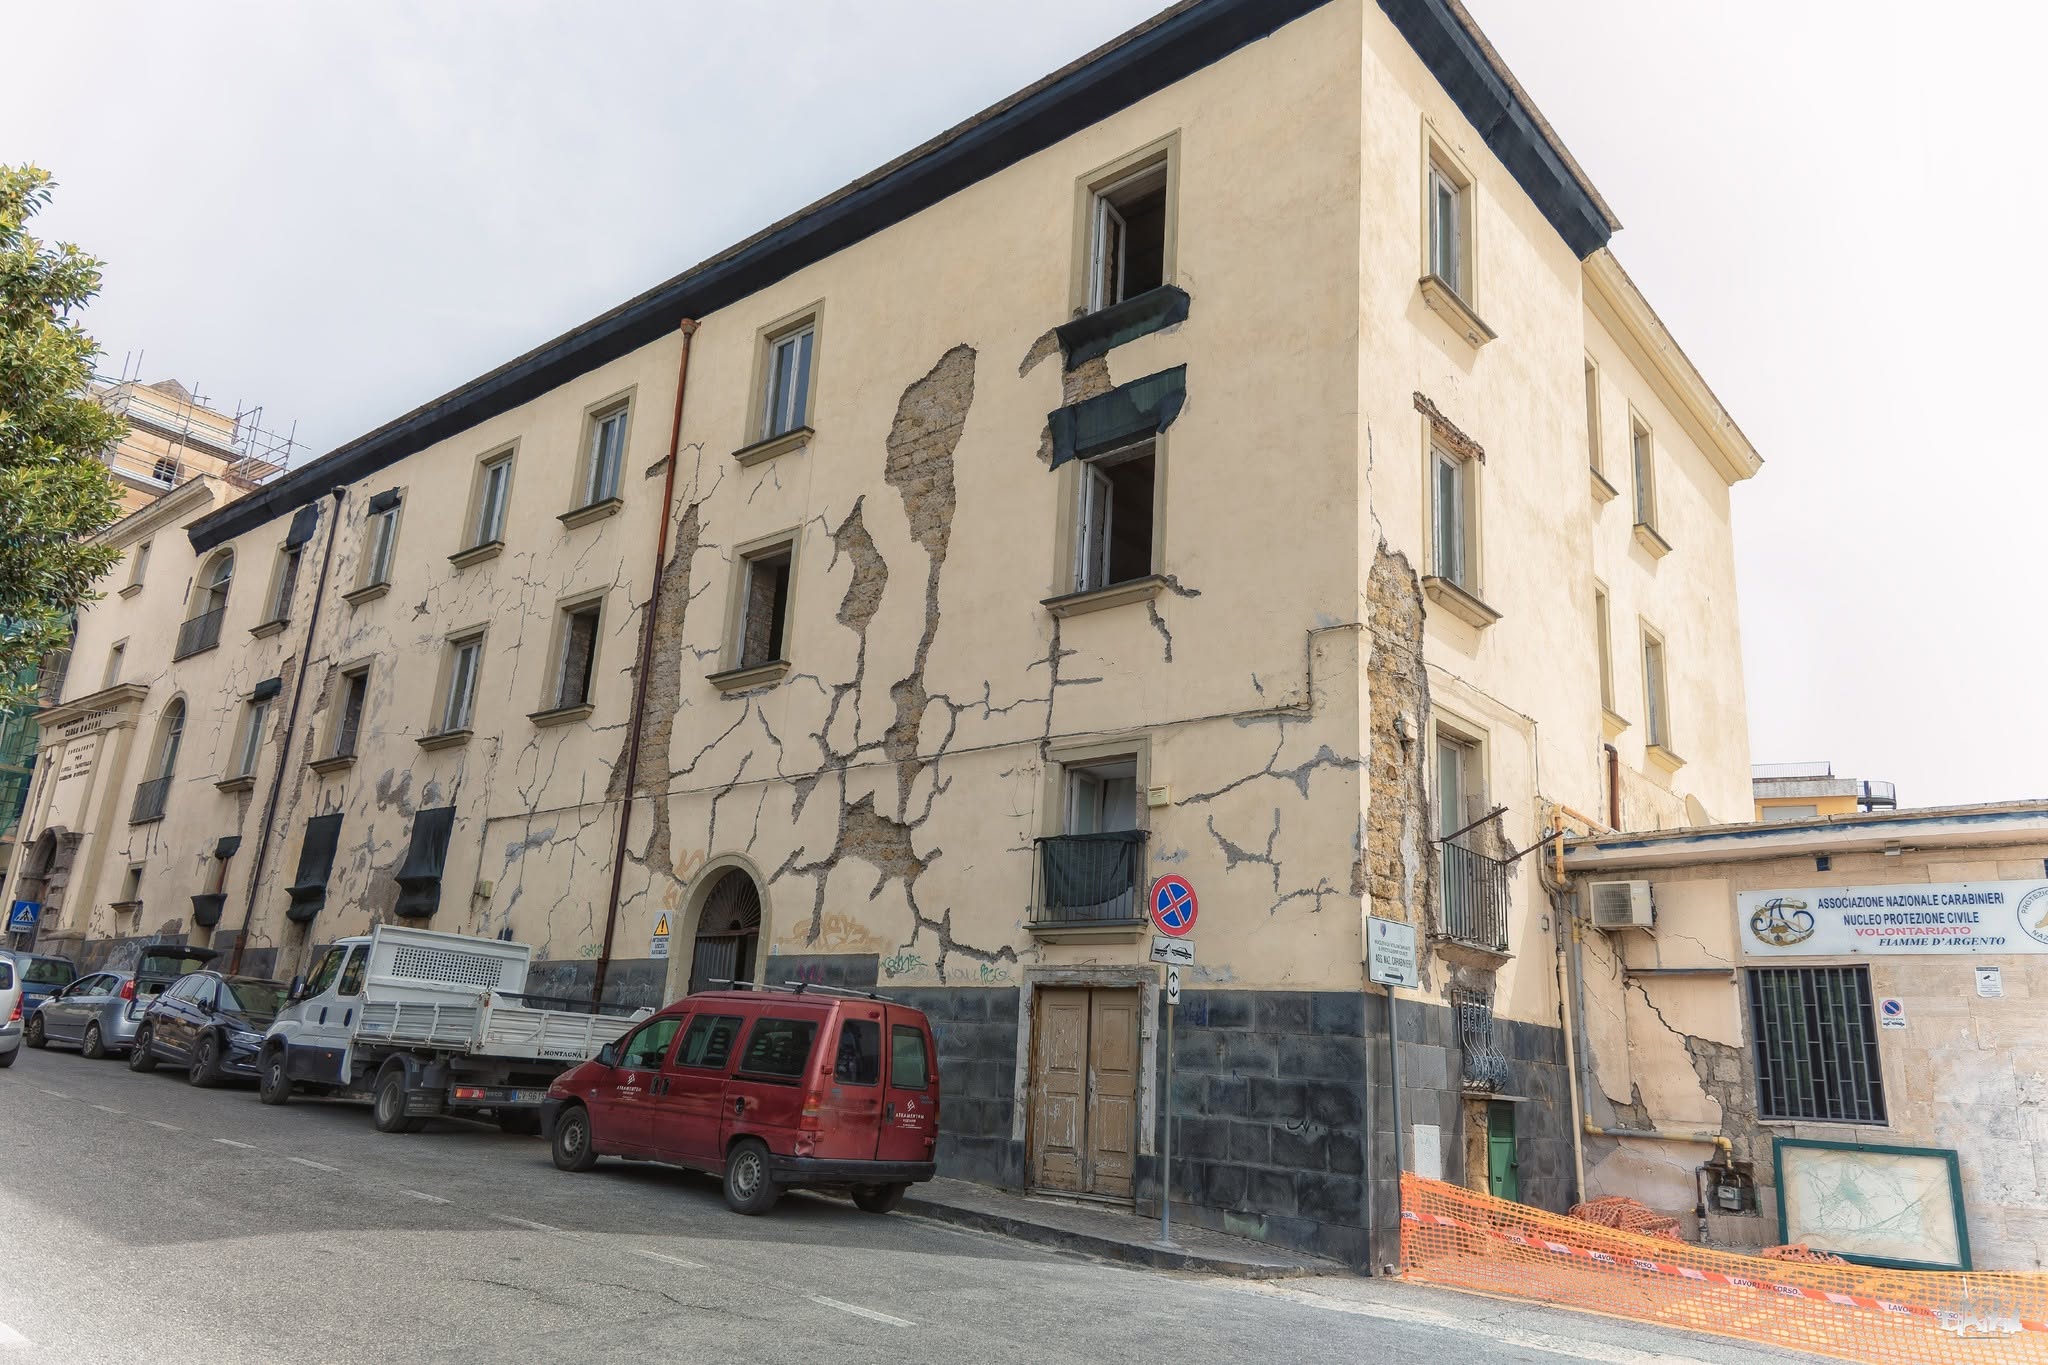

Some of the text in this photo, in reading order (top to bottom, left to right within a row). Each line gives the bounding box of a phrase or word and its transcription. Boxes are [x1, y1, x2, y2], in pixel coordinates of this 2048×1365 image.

[1817, 892, 2005, 910] ASSOCIAZIONE NAZIONALE CARABINIERI
[1843, 911, 1979, 926] NUCLEO PROTEZIONE CIVILE
[1855, 926, 1972, 937] VOLONTARIATO
[1879, 936, 2006, 947] FIAMME D'ARGENTO
[543, 1050, 582, 1059] MONTAGNA
[1594, 1253, 1618, 1263] LAVORI
[1733, 1279, 1760, 1289] LAVORI
[1888, 1304, 1917, 1314] LAVORI
[1932, 1310, 1959, 1320] COSO
